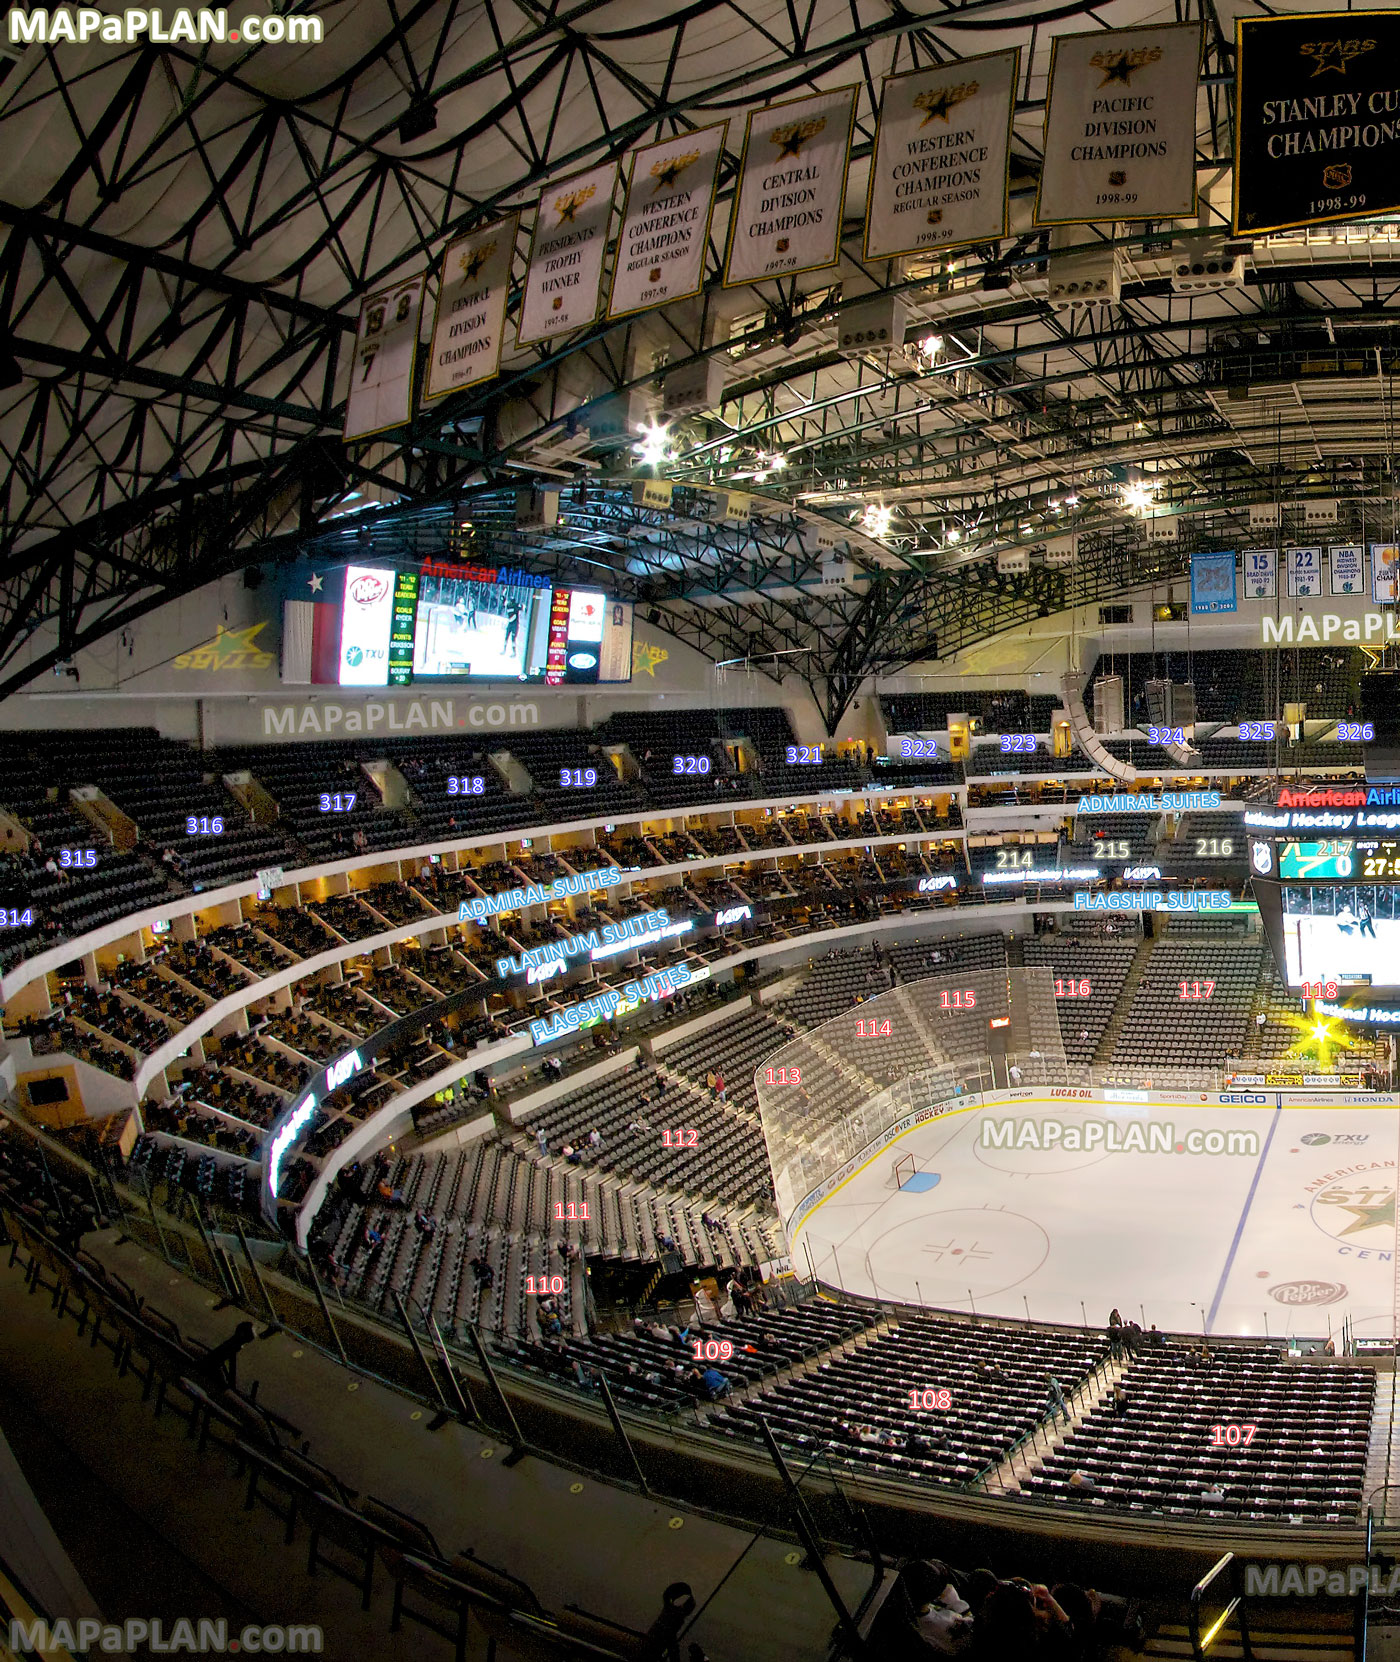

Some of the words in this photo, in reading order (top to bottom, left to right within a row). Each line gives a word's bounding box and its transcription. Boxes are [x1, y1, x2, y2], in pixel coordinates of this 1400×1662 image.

[1301, 39, 1378, 55] STARS
[1092, 97, 1153, 114] PACIFIC
[1263, 92, 1361, 124] STANLEY
[1085, 120, 1156, 136] DIVISION
[907, 130, 975, 156] WESTERN
[1071, 141, 1167, 161] CHAMPIONS
[892, 147, 988, 180] CONFERENCE
[762, 166, 819, 190] CENTRAL
[895, 169, 980, 198] CHAMPIONS
[761, 188, 816, 213] DIVISION
[1095, 194, 1138, 204] 1998-99
[1310, 195, 1366, 213] 1998-99
[750, 209, 823, 238] CHAMPIONS
[1252, 555, 1268, 570] 15
[1297, 552, 1312, 567] 22
[1292, 813, 1354, 829] Hockey
[1337, 857, 1351, 876] 0
[1050, 1089, 1076, 1097] LUCAS
[1219, 1095, 1266, 1103] GEICO
[1331, 1134, 1369, 1142] TXU
[1304, 1161, 1396, 1193] AMERICAN
[1283, 1286, 1332, 1302] Pepper
